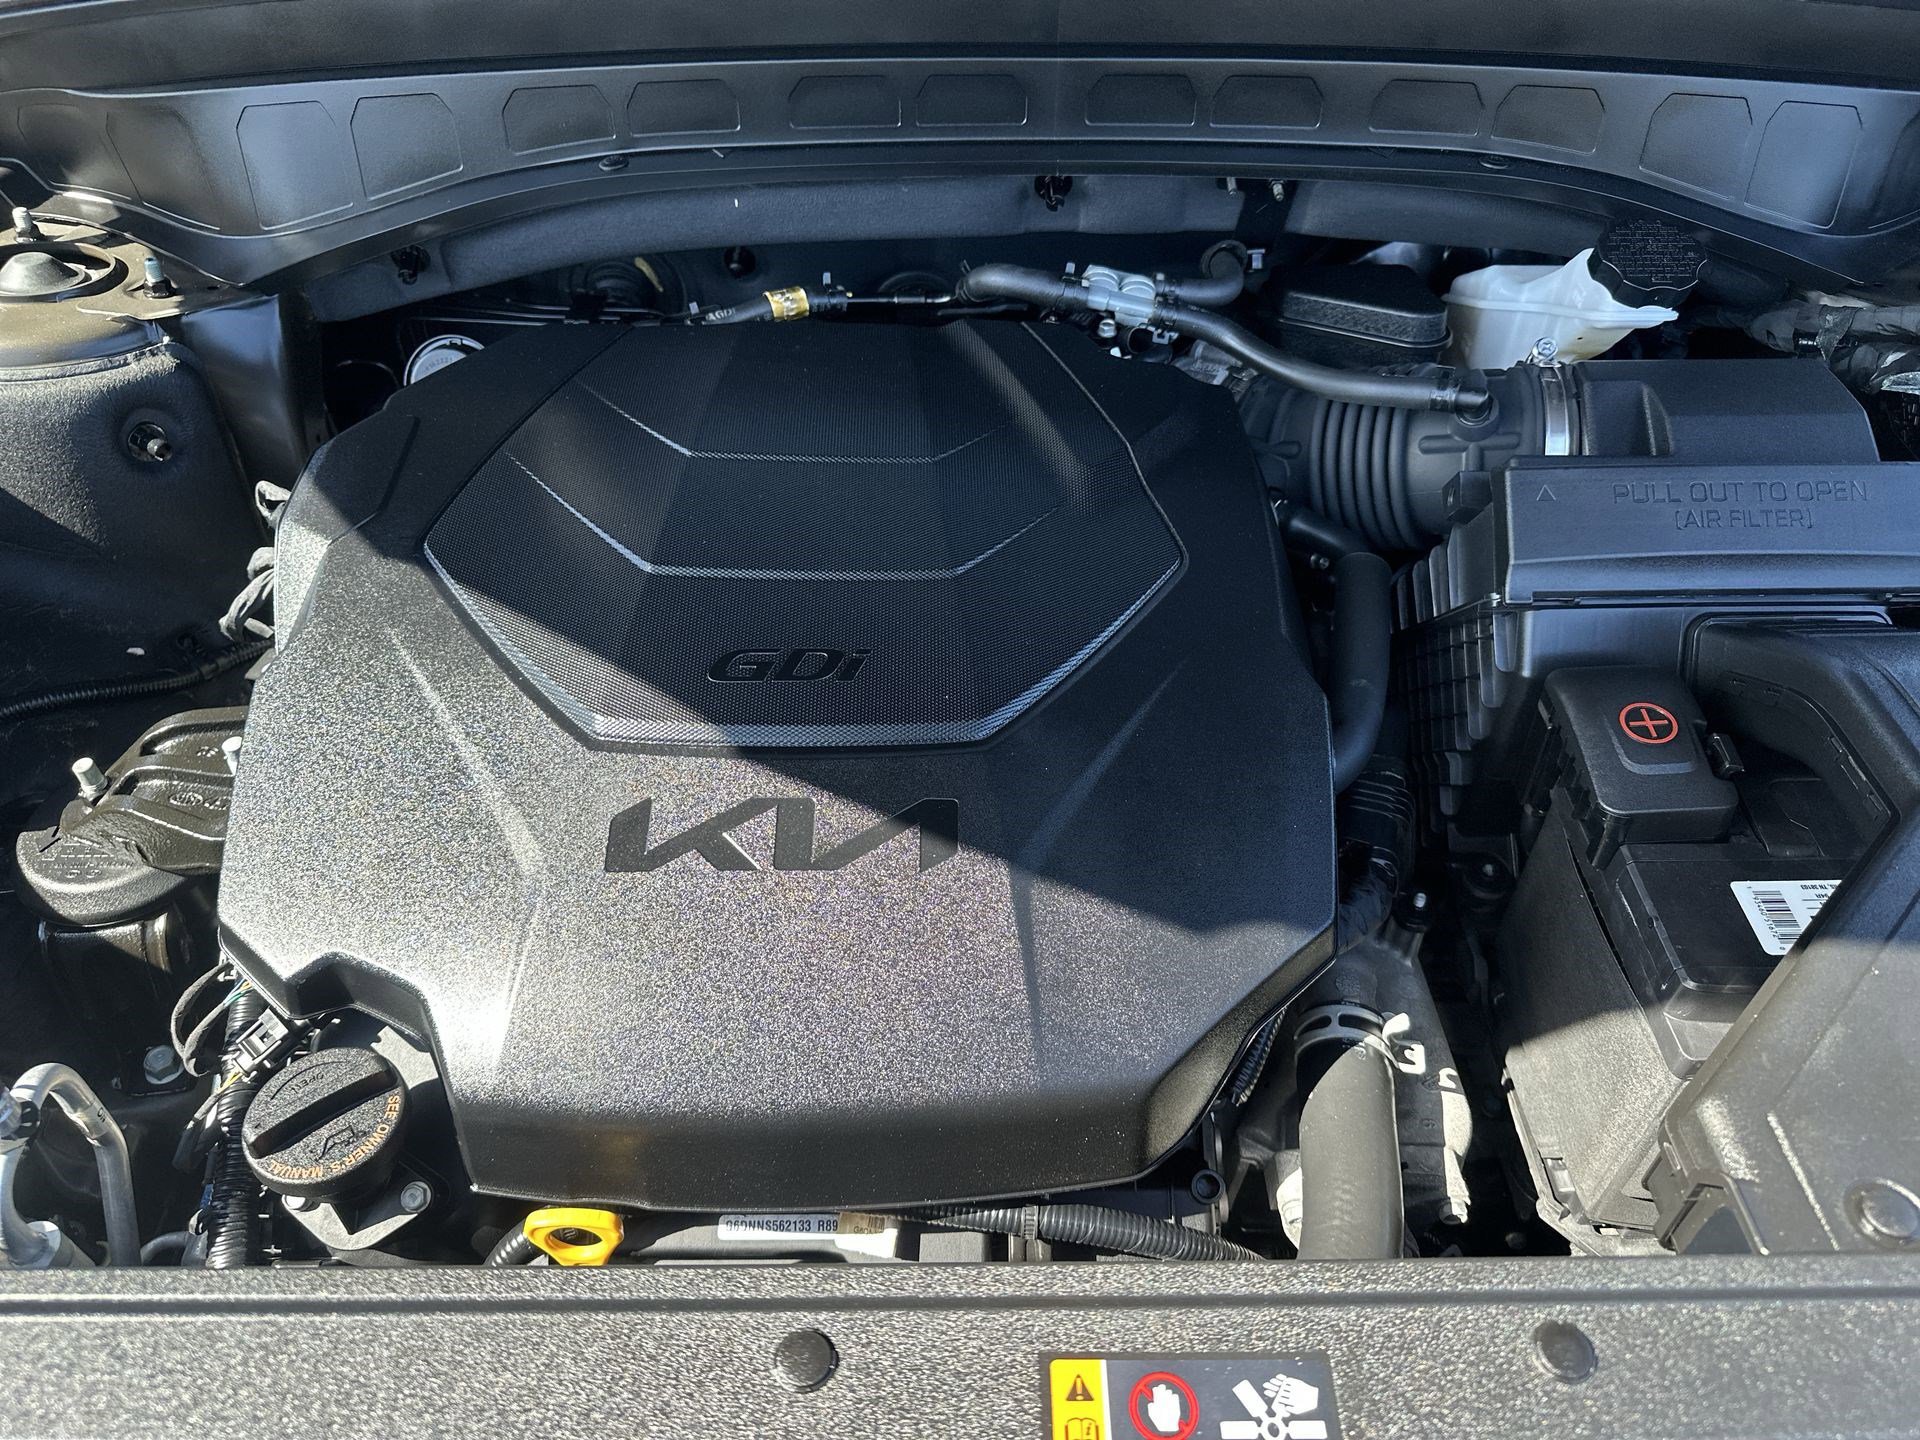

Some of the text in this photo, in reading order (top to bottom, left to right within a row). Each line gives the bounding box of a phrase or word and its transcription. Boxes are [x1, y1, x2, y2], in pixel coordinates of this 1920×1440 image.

[1612, 480, 1867, 503] PULL OUT TO OPEN
[604, 797, 960, 874] KIA
[291, 1072, 325, 1094] OPEN
[267, 1095, 400, 1179] SEE OWNER'S MANUAL
